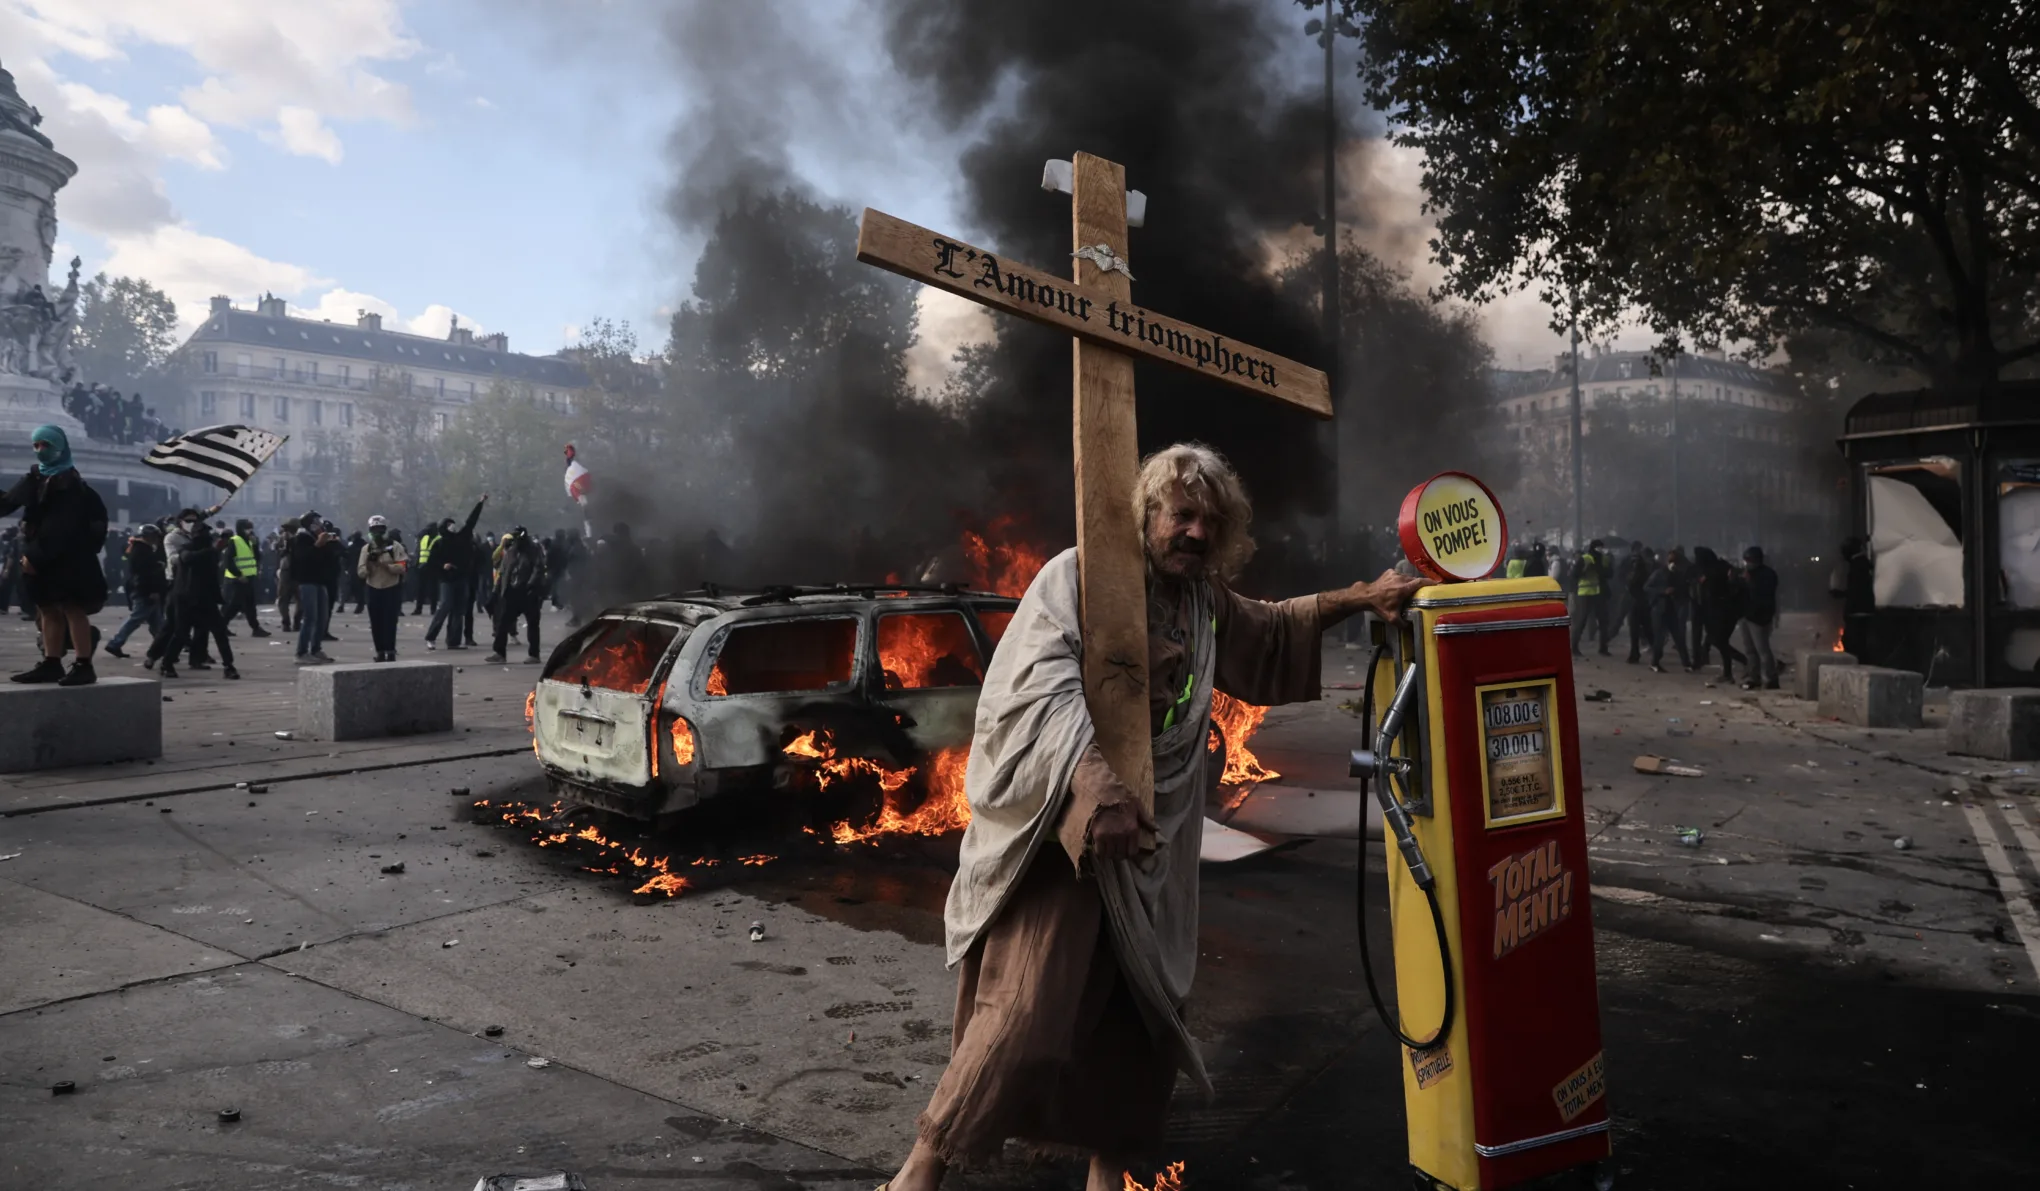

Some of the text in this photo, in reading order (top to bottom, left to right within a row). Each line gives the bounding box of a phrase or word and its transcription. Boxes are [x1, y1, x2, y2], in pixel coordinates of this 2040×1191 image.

[933, 238, 1280, 388] L'Amour triomphera
[1424, 498, 1479, 533] ON VOUS
[1433, 519, 1487, 559] POMPE!
[1488, 841, 1561, 909] TOTAL
[1494, 871, 1571, 958] MENT!
[1418, 1052, 1452, 1083] SPIRITUELLE
[1557, 1085, 1568, 1102] ON
[1568, 1071, 1587, 1094] VOUS
[1588, 1066, 1594, 1080] A
[1563, 1092, 1587, 1116] TOTAL
